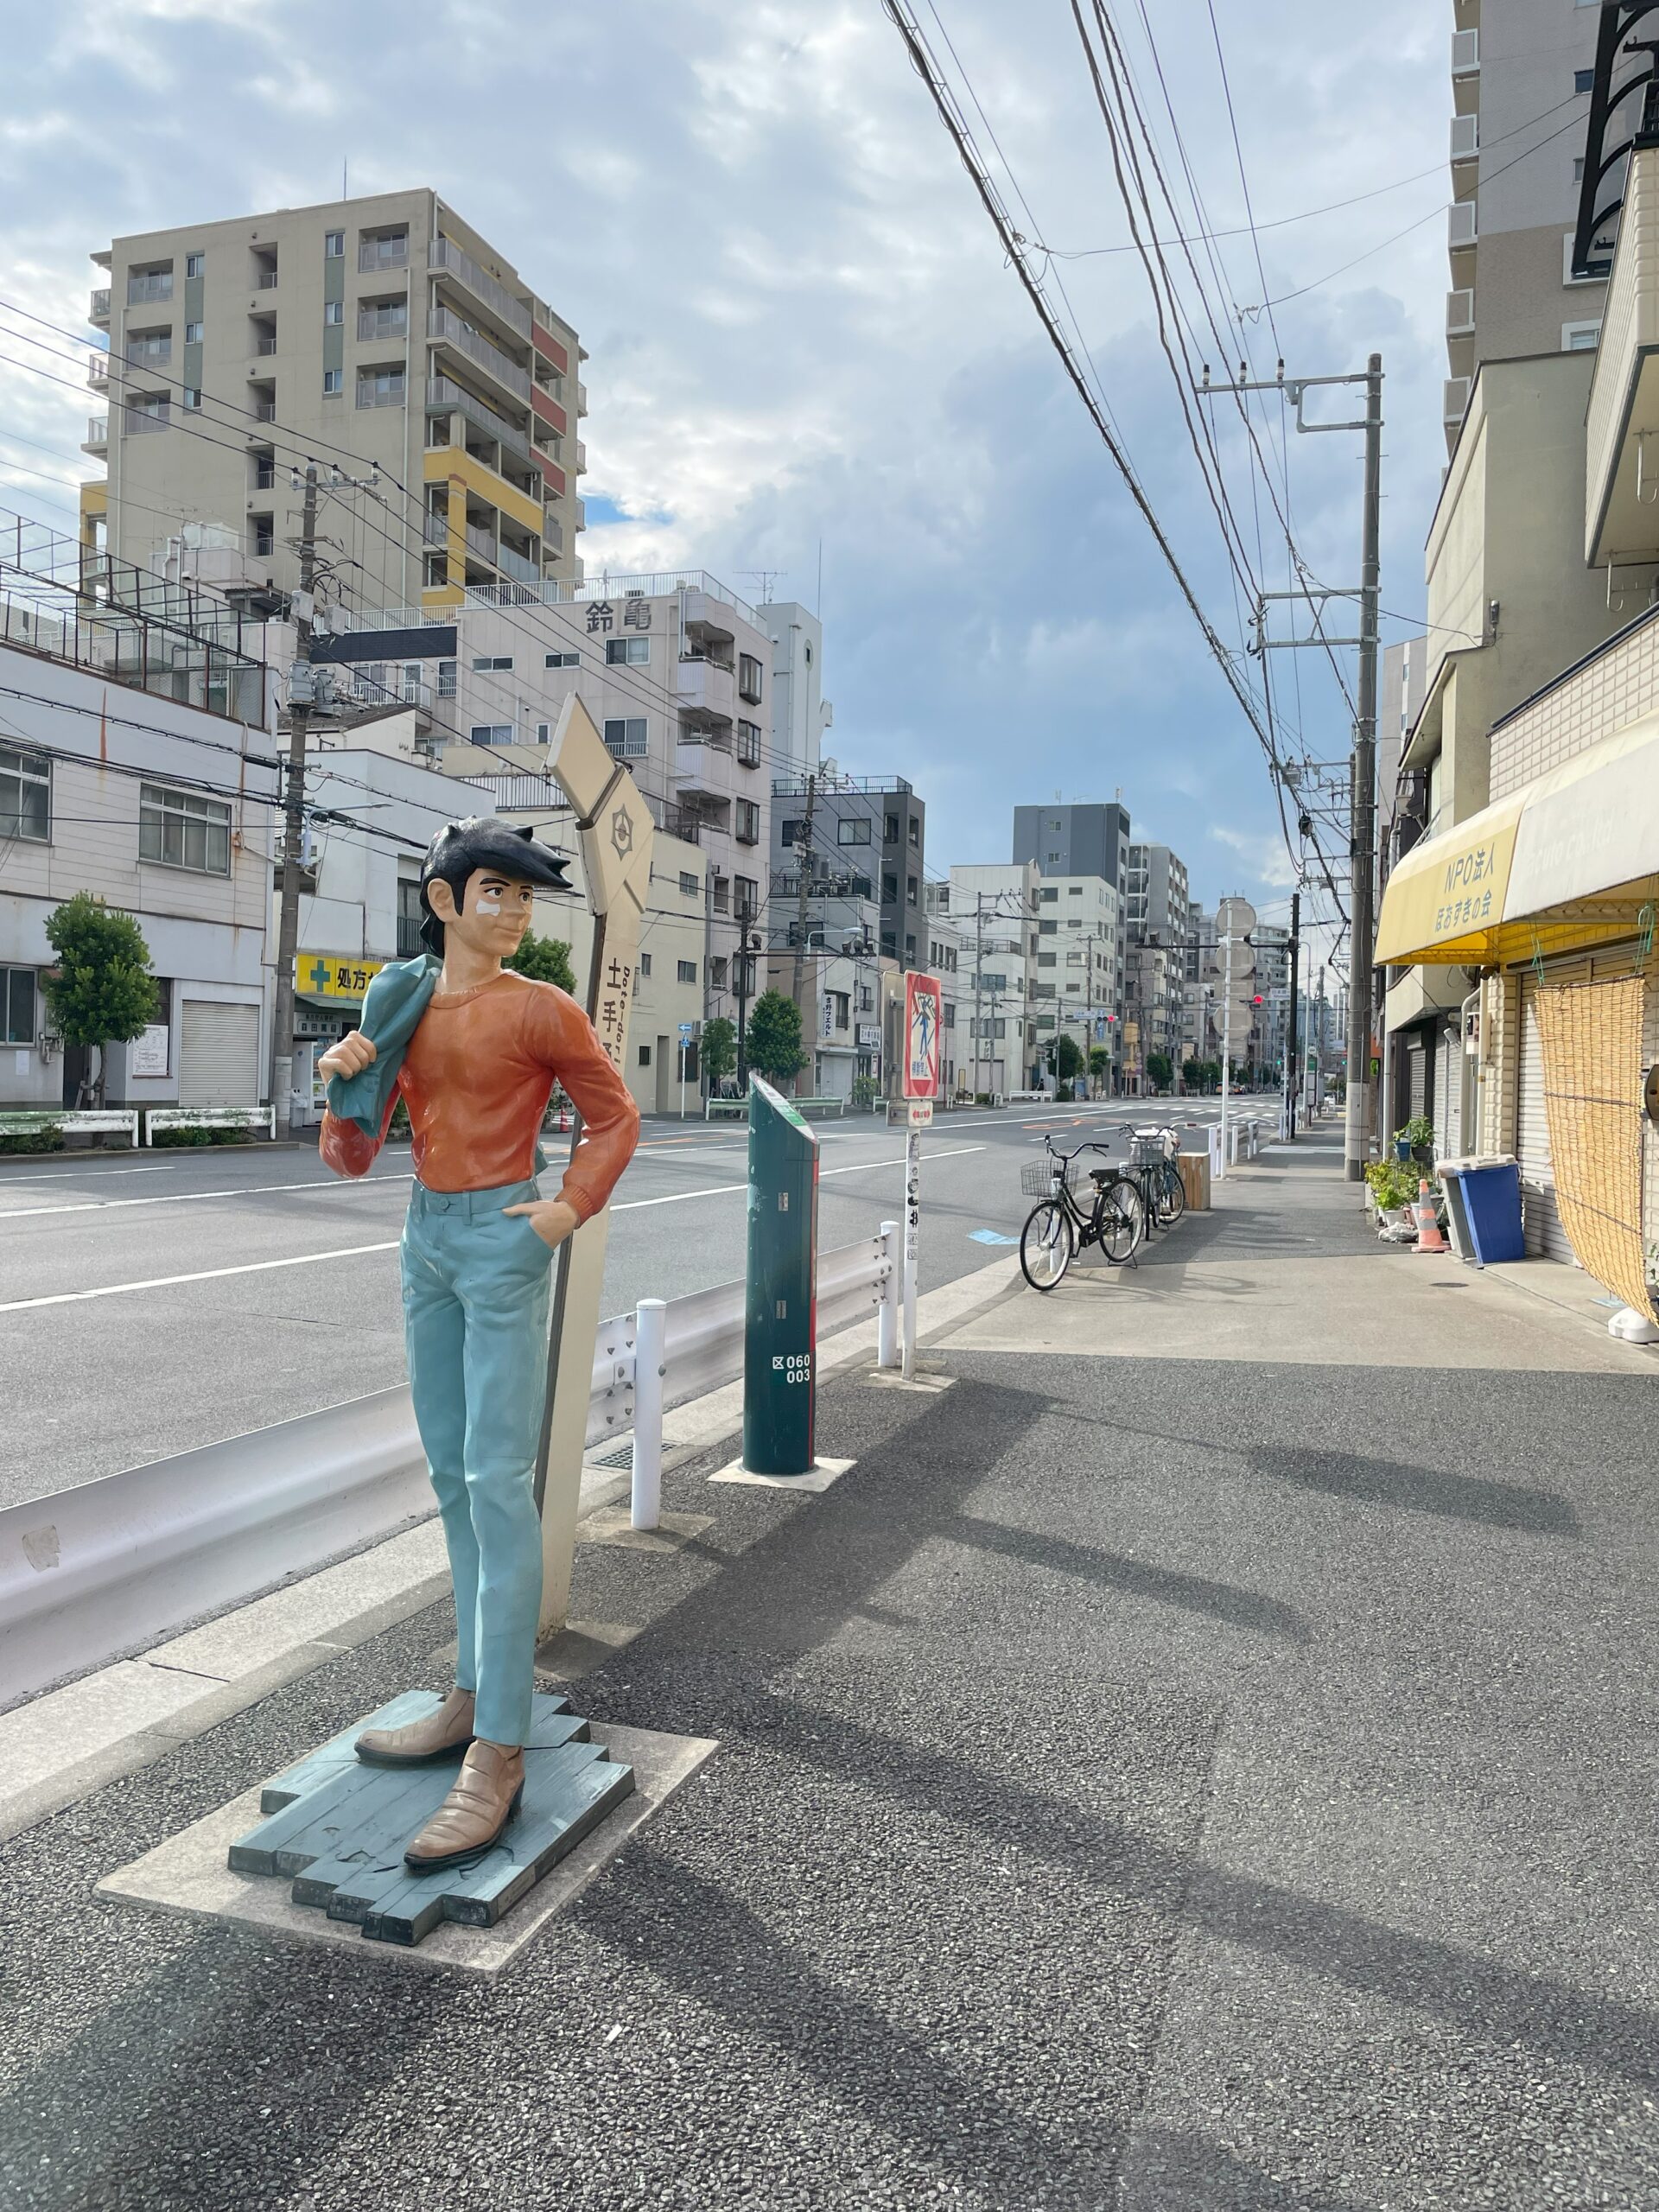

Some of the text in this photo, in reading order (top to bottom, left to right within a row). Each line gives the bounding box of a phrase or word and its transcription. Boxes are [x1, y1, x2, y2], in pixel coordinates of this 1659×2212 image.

[1445, 842, 1494, 893] NPO法人
[614, 966, 630, 1064] Dote-dori
[787, 1369, 810, 1383] 003
